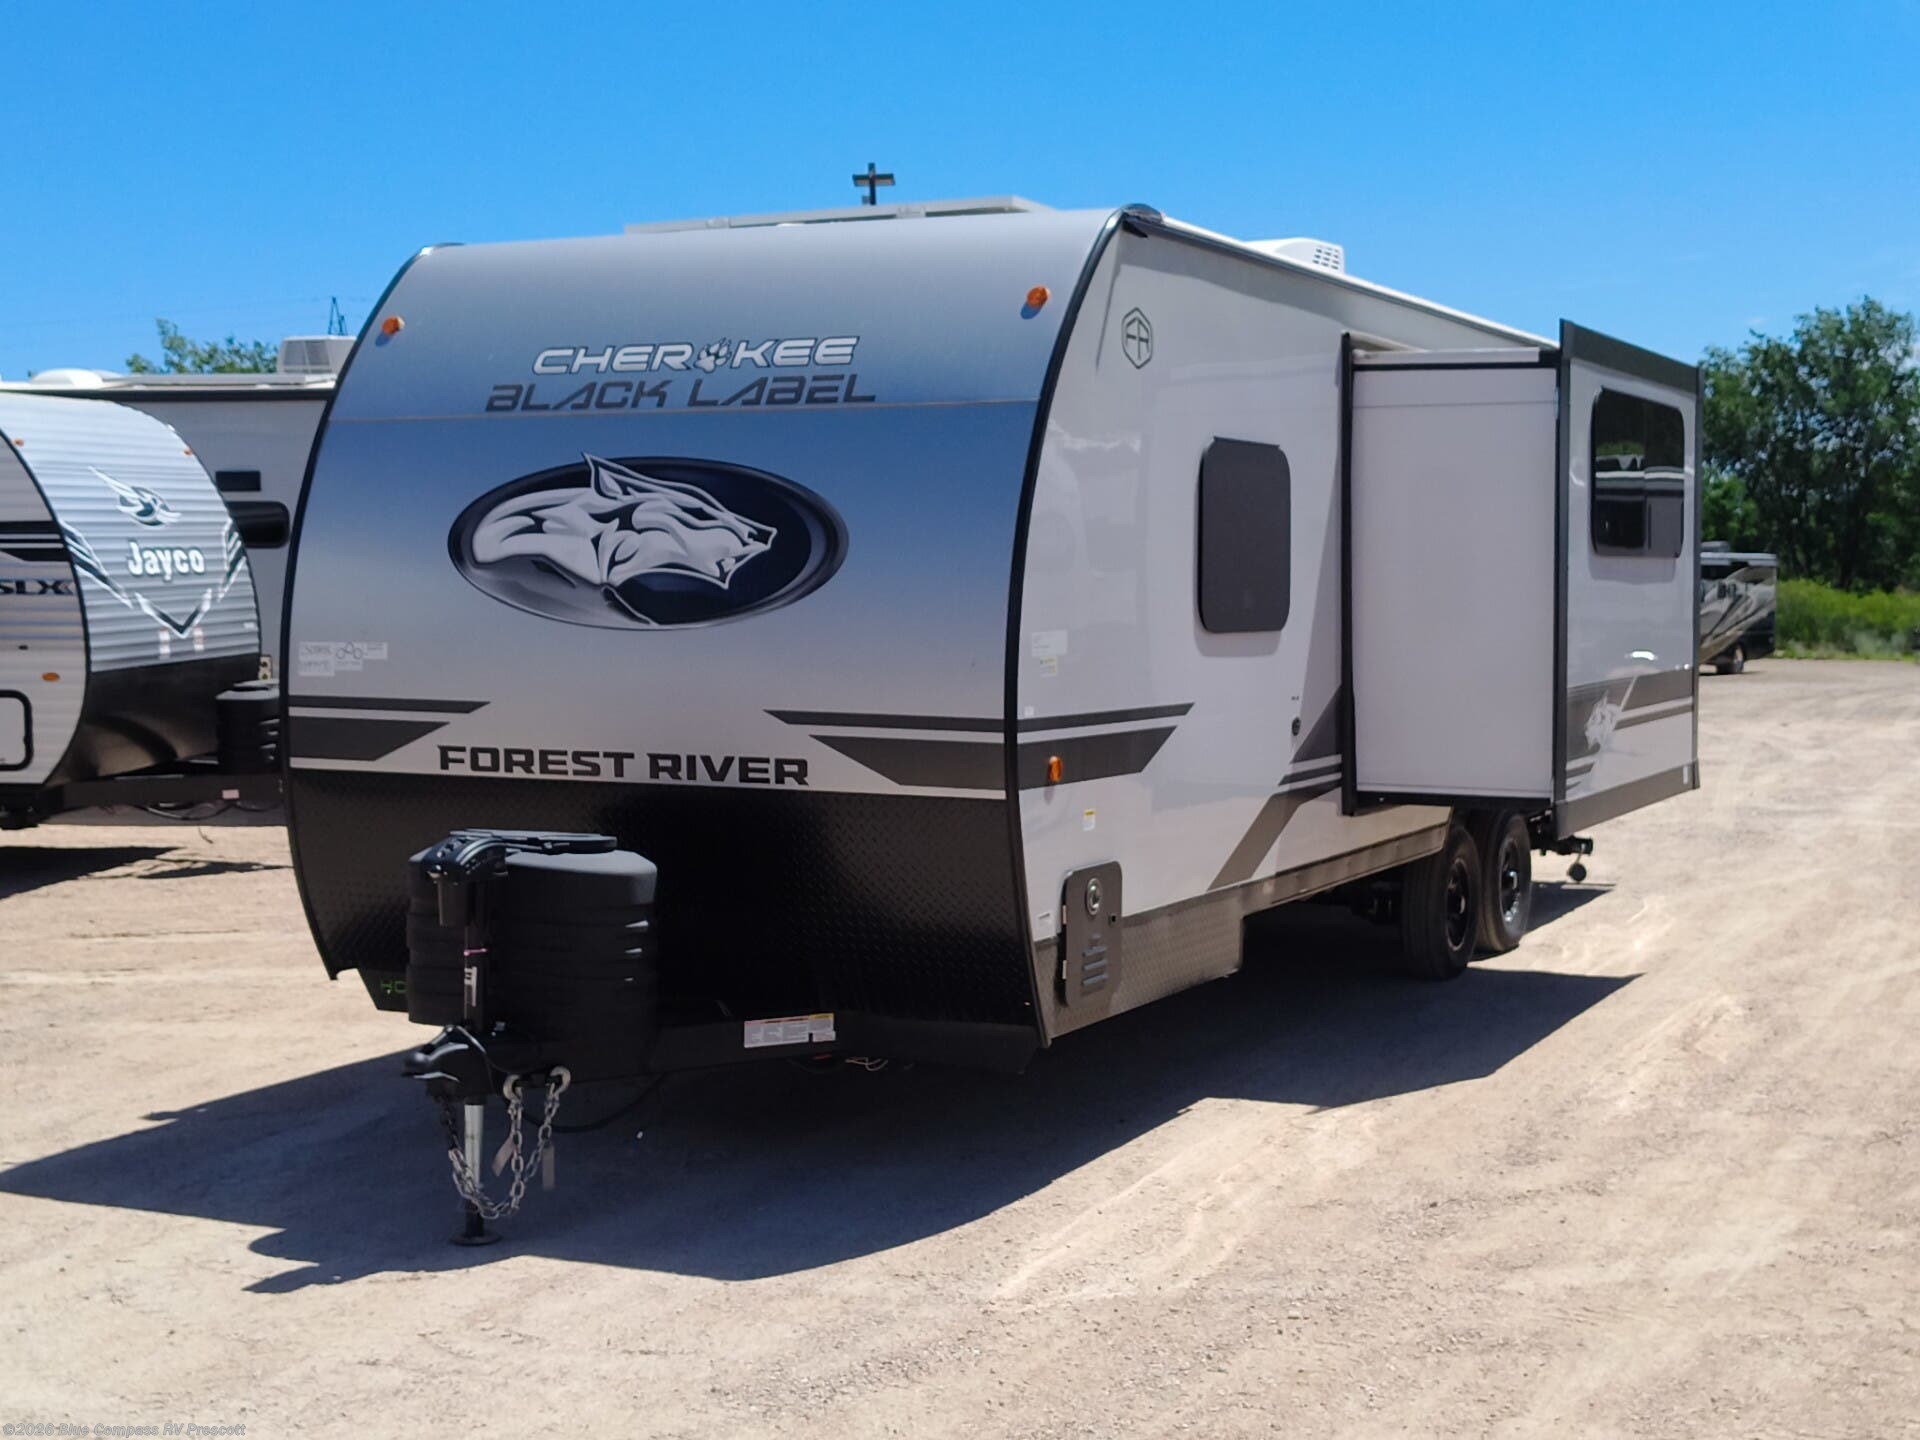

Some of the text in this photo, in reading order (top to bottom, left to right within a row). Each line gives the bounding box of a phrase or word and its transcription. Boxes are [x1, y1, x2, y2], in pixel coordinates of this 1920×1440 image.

[485, 374, 876, 412] BLACK LABEL
[127, 539, 206, 582] Jayco
[437, 744, 809, 786] FOREST RIVER
